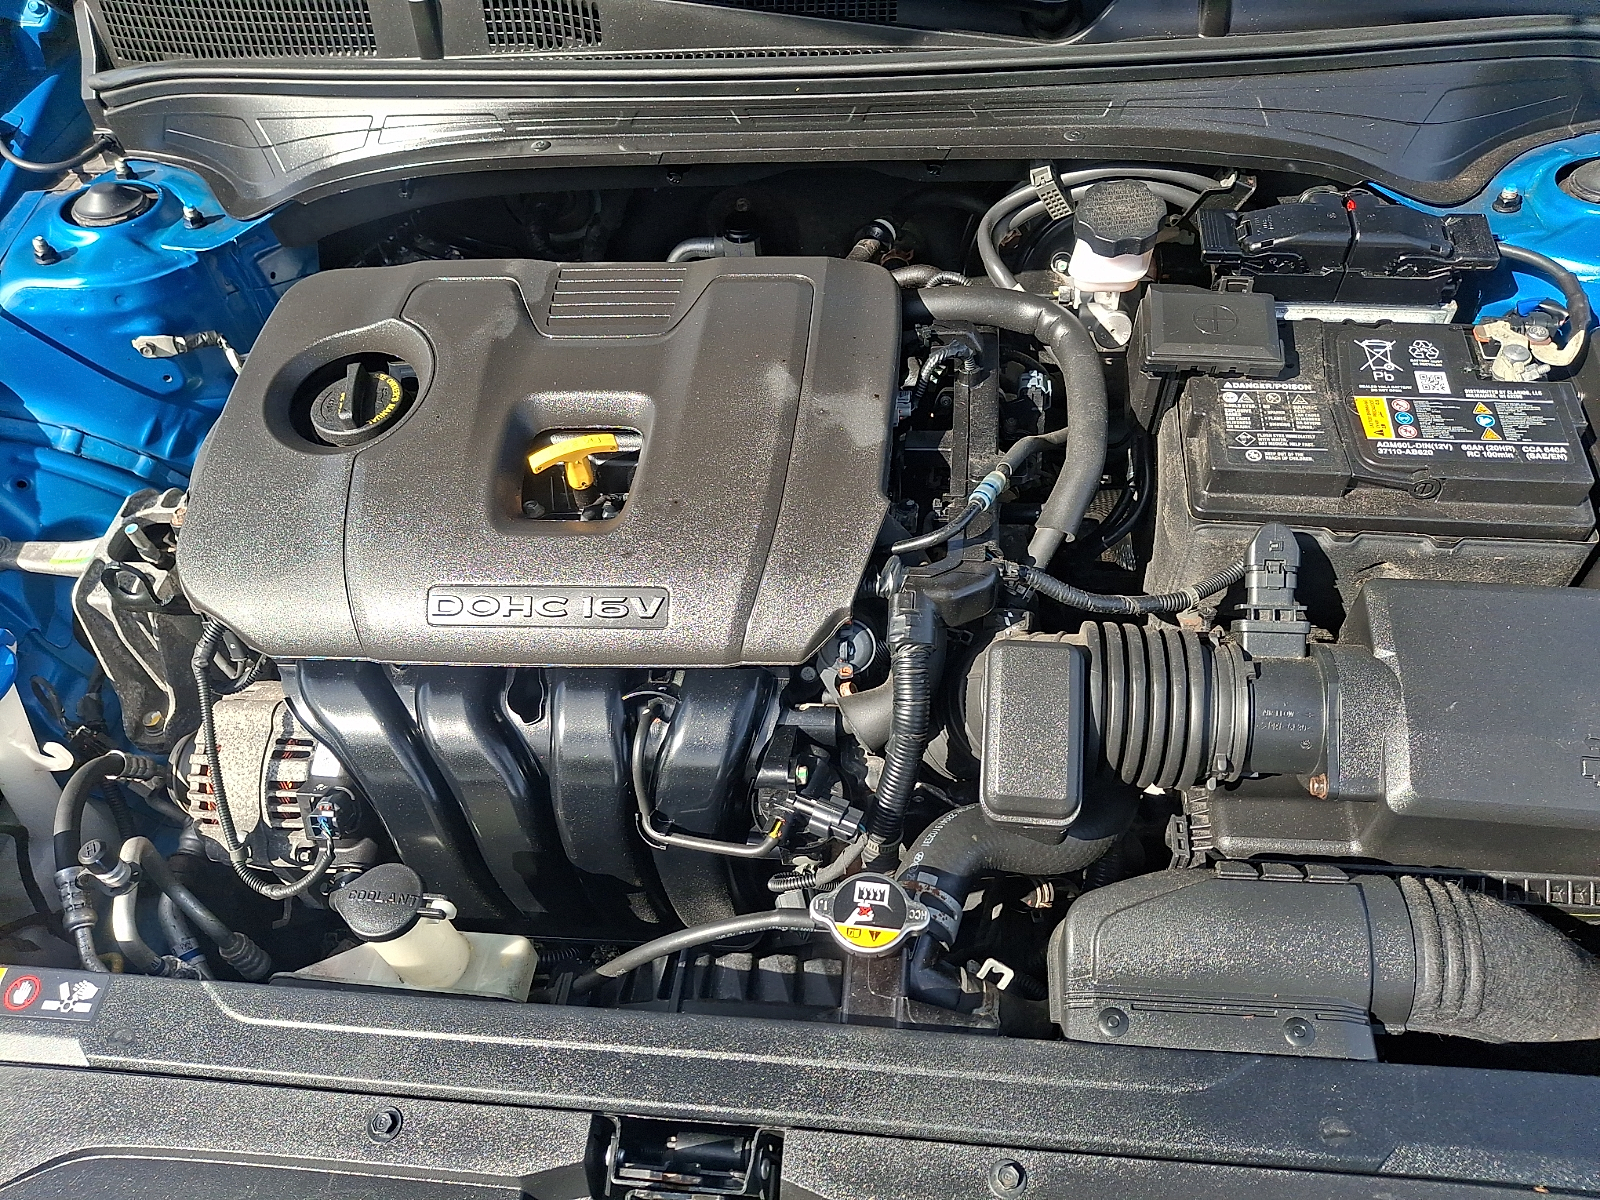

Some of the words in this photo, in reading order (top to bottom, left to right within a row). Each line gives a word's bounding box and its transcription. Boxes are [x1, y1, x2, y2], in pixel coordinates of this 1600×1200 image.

[1373, 371, 1394, 382] Pb
[1232, 382, 1312, 391] DANGER/POISON
[1485, 444, 1516, 453] (20HR)
[1482, 451, 1515, 459] 100min
[1526, 452, 1568, 461] (SAE/EN)
[431, 595, 568, 618] DOHC
[582, 595, 665, 619] 16V
[348, 889, 420, 907] COOLANT
[908, 909, 927, 920] HCC
